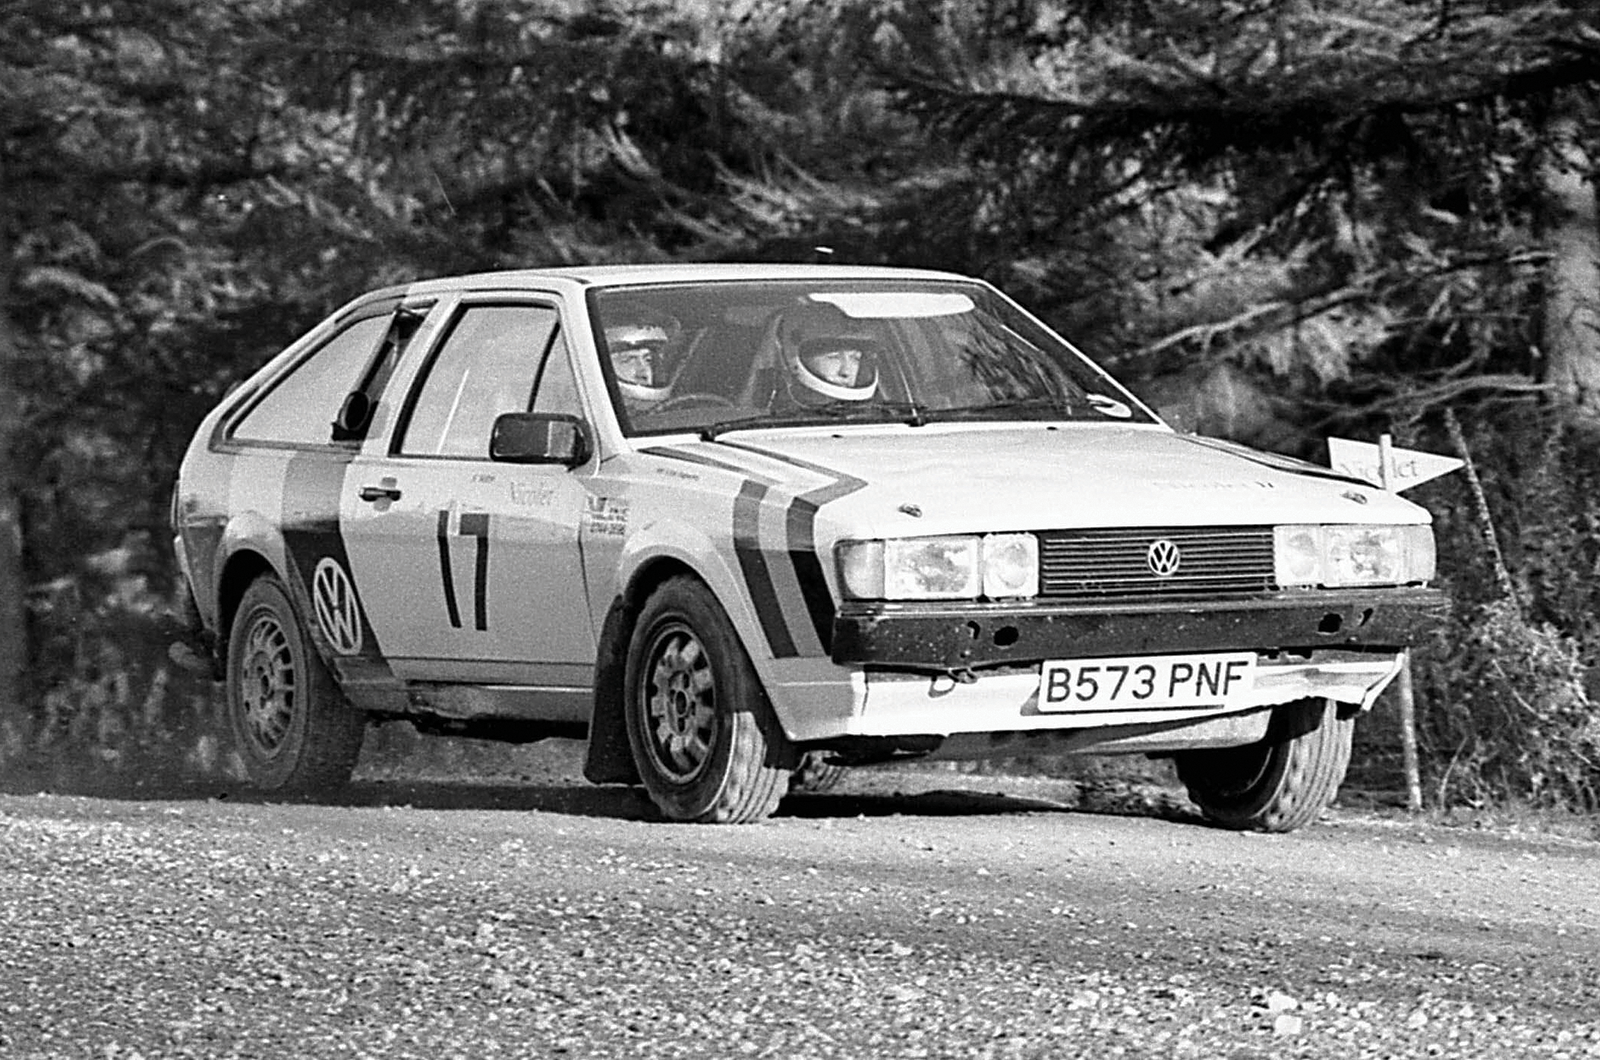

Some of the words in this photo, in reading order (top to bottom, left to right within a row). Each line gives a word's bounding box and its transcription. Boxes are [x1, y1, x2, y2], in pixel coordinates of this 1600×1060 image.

[1340, 456, 1418, 481] Niclet
[437, 509, 490, 631] 17
[1148, 540, 1181, 575] VW
[313, 557, 363, 655] VW
[1047, 664, 1157, 703] B573
[1169, 660, 1249, 698] PNF
